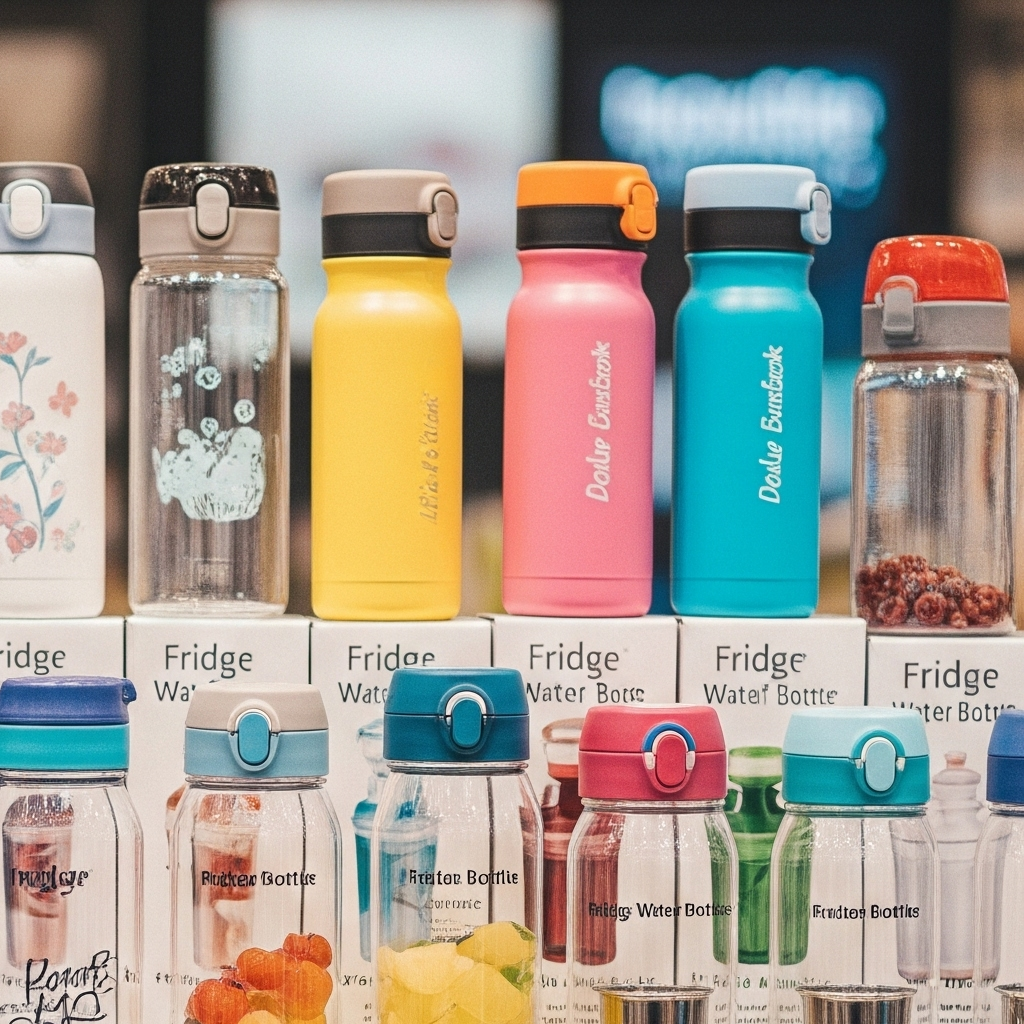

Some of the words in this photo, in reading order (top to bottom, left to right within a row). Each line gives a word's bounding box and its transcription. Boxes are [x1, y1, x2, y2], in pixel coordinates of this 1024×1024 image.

[165, 643, 253, 680] Fridge
[347, 644, 436, 669] Fridge
[529, 641, 620, 680] Fridge
[716, 643, 807, 680] Fridge
[904, 659, 999, 697] Fridge
